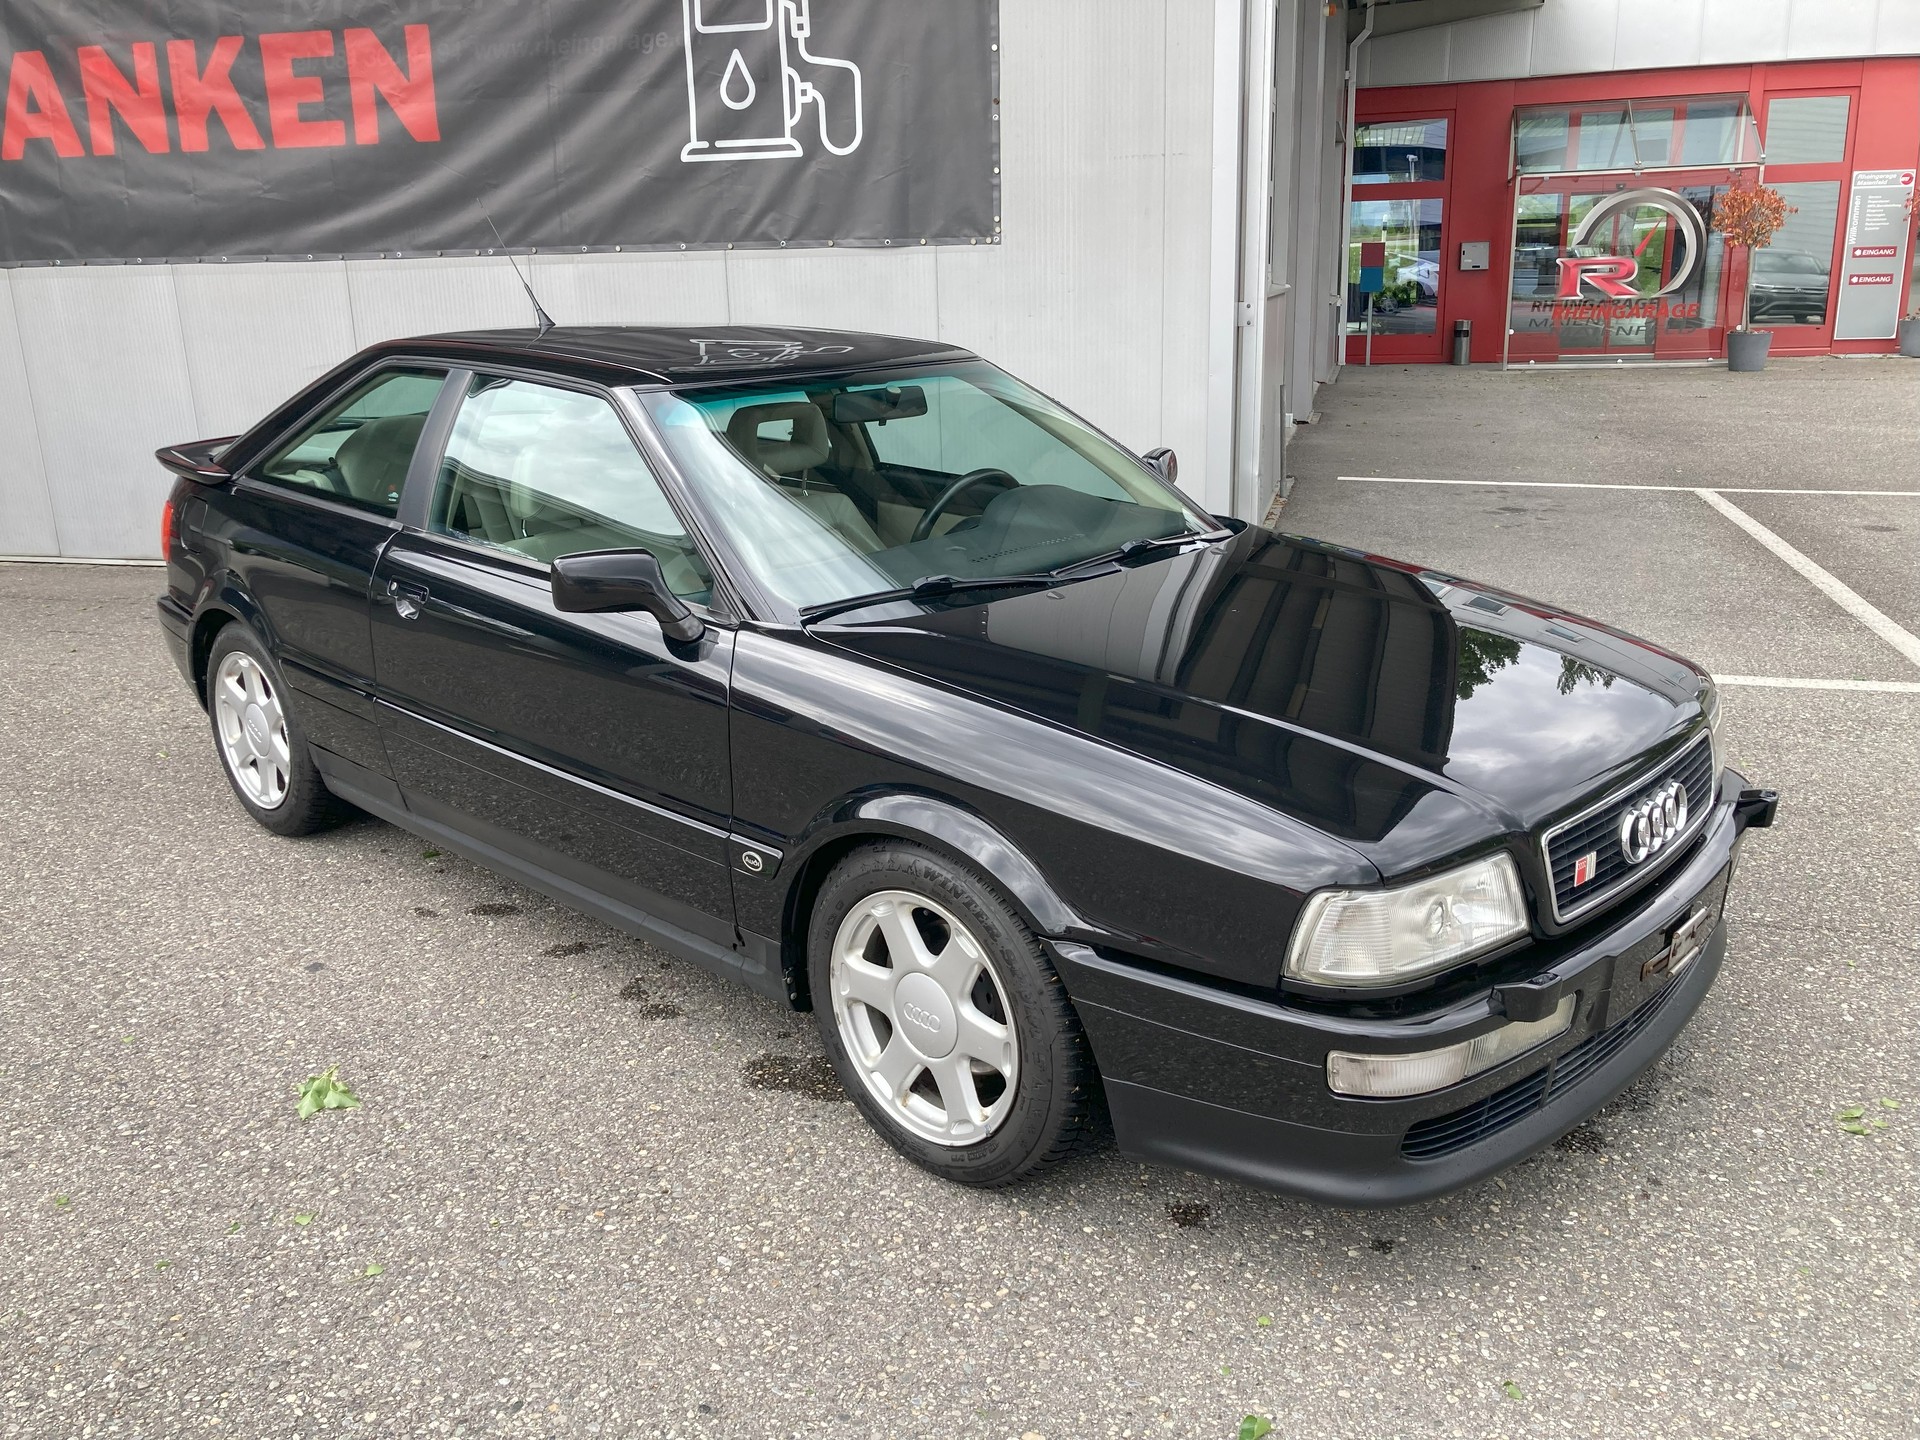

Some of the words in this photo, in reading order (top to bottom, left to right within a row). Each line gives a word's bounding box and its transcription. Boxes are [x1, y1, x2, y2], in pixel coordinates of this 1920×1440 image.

[1848, 195, 1861, 245] Willkommen
[1862, 248, 1895, 256] EINGANG
[1551, 302, 1700, 320] RHEINGARAGE
